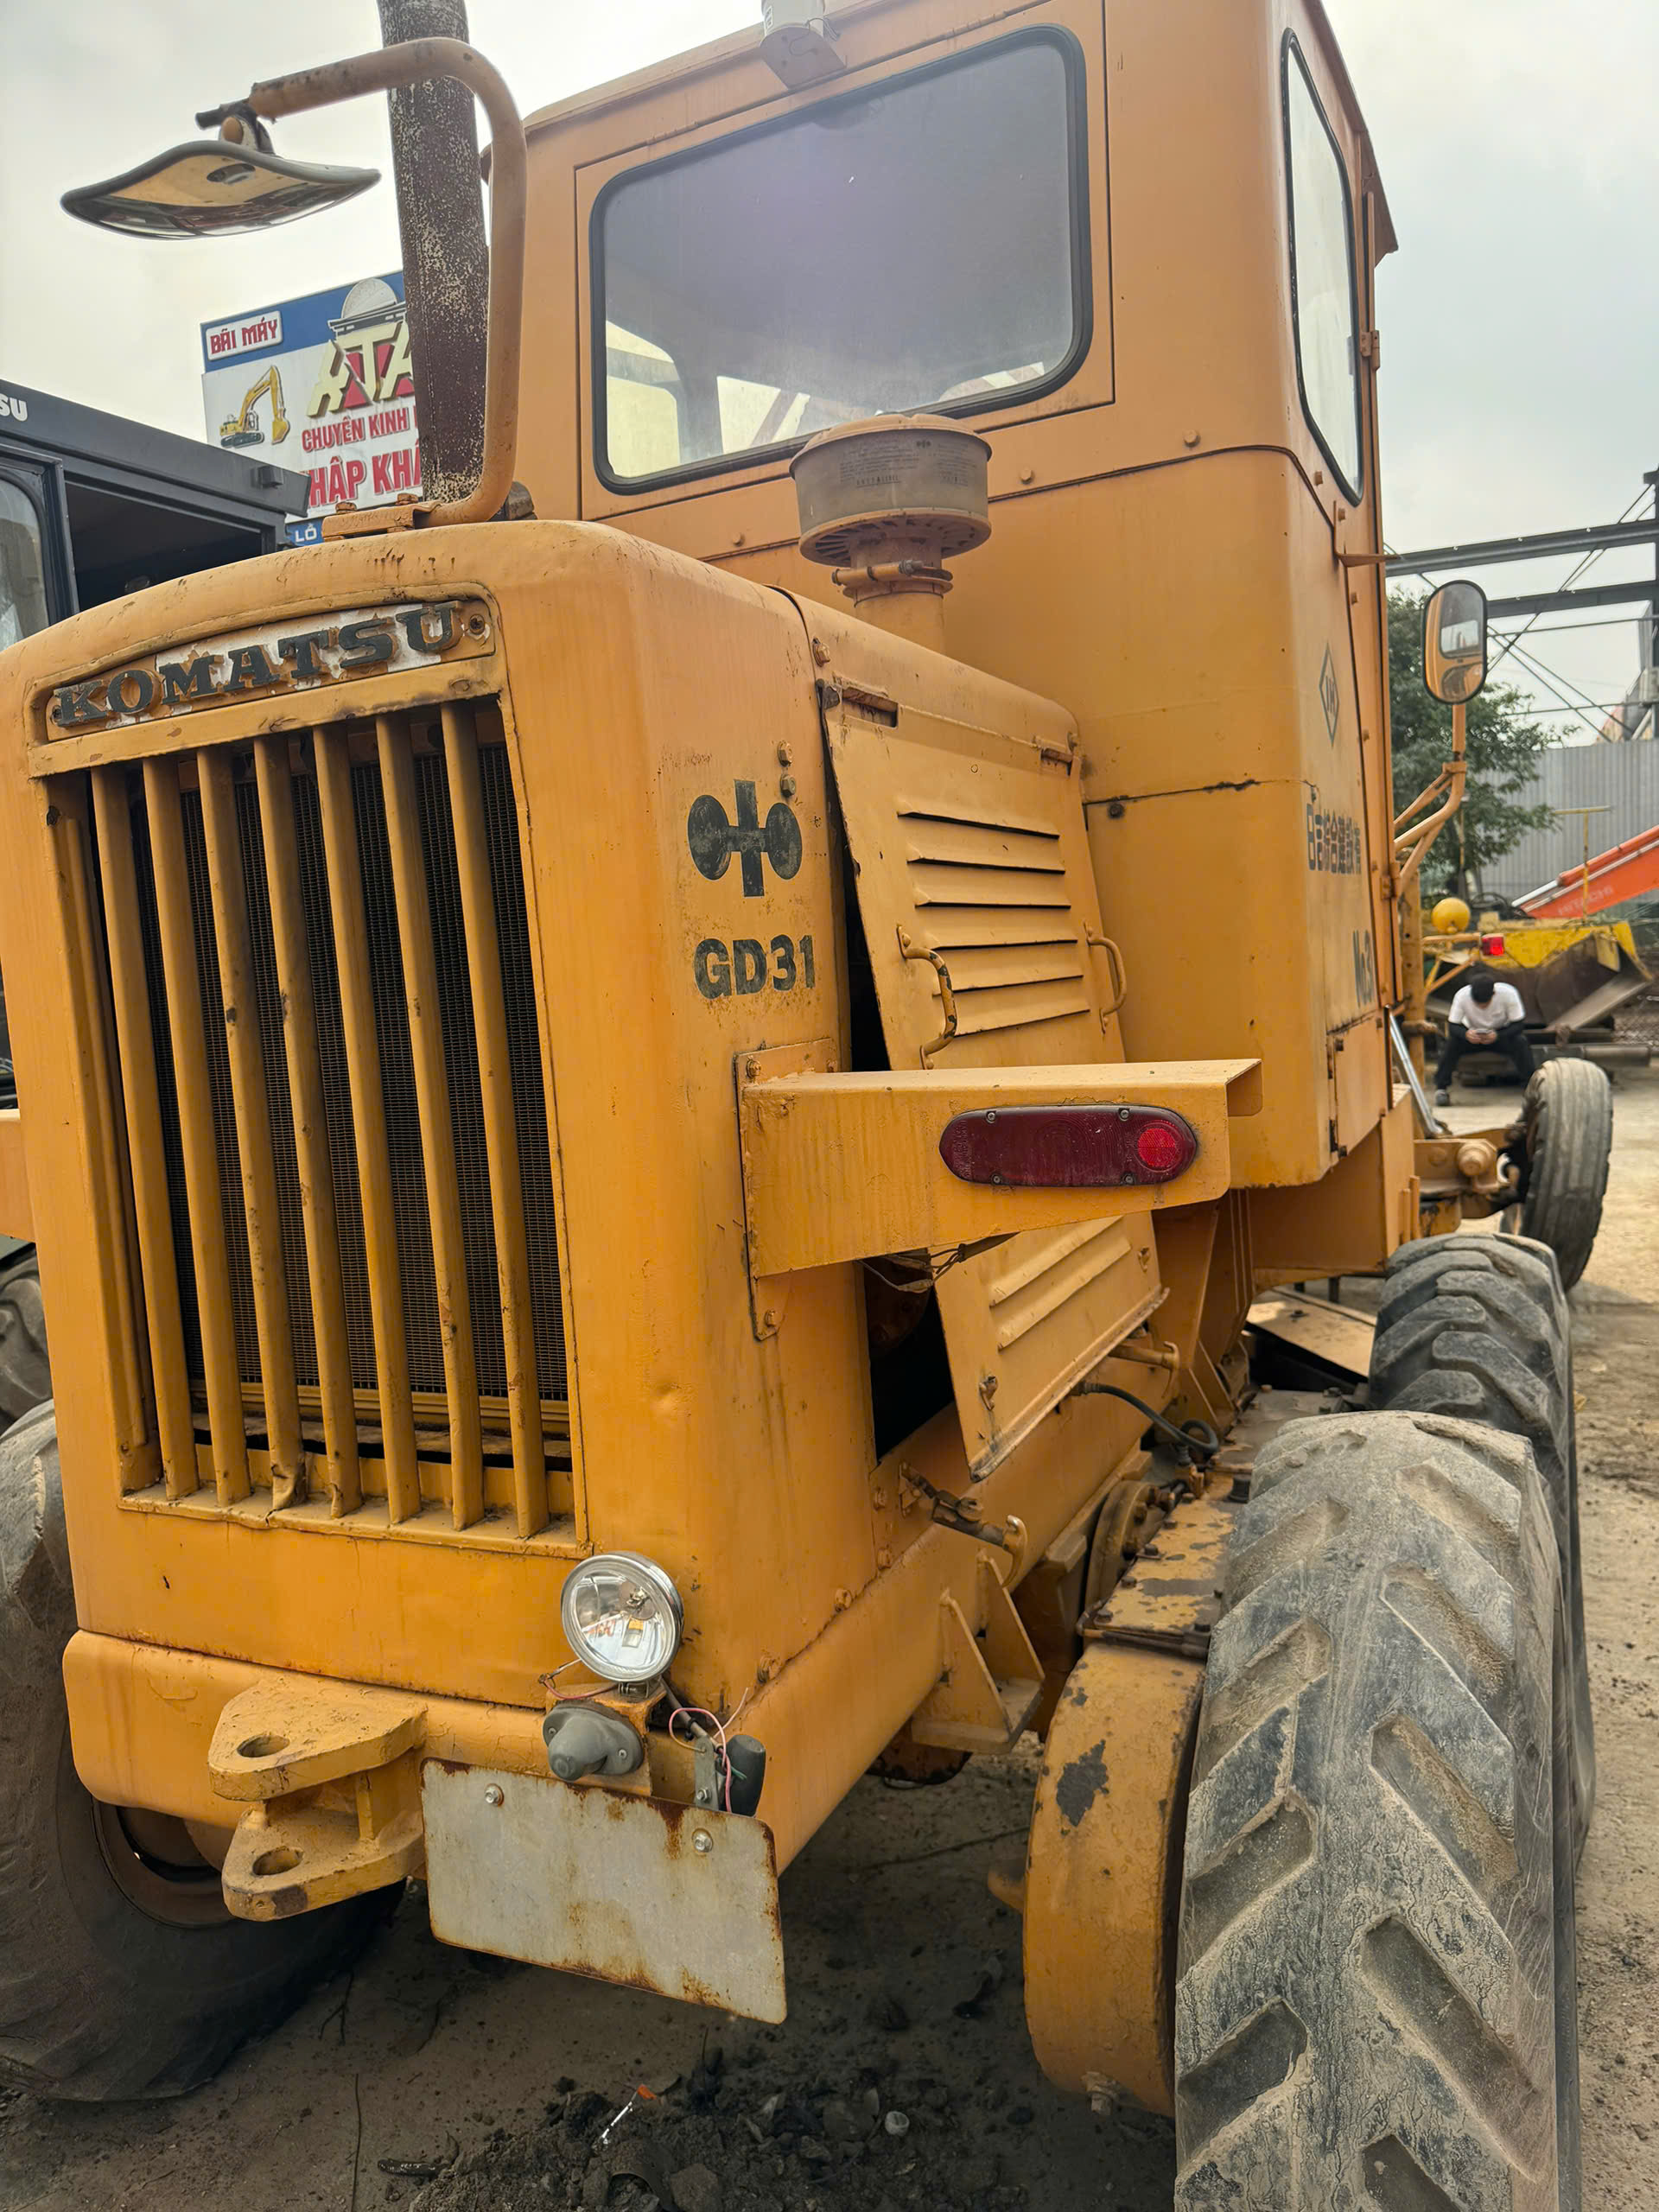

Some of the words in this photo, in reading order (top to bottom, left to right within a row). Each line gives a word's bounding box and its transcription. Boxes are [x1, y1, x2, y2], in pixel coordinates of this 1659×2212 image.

[210, 327, 237, 355] BÃI
[242, 316, 277, 346] MÁY
[302, 416, 365, 452] CHUYÊN
[368, 407, 409, 439] KINH
[53, 603, 461, 728] KOMATSU
[694, 933, 816, 1000] GD31
